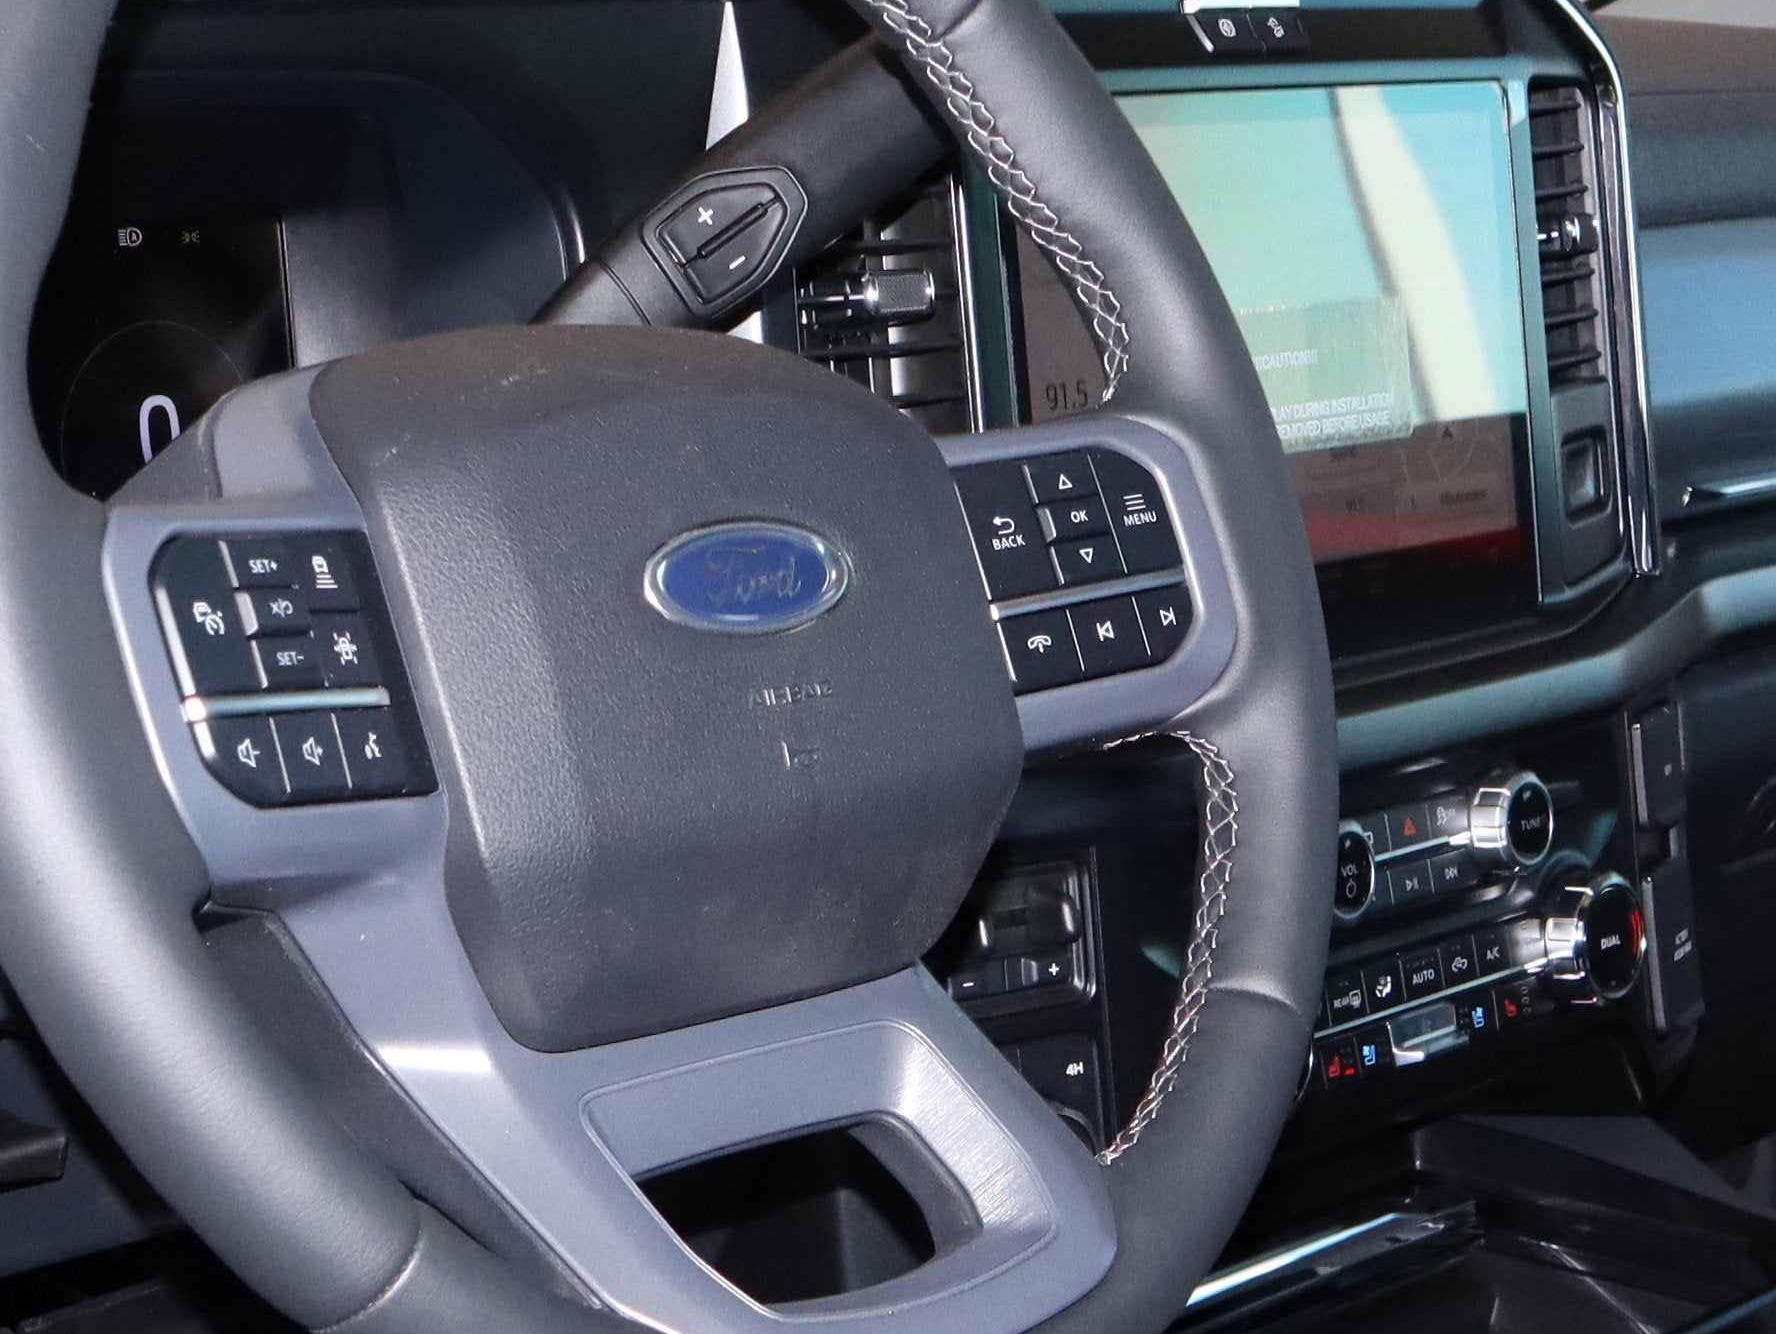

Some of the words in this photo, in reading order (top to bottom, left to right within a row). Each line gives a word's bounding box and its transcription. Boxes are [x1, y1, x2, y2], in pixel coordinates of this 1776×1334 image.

[1044, 382, 1090, 412] 91.5
[1070, 509, 1089, 524] OK
[1123, 509, 1158, 527] MENU
[991, 534, 1026, 551] BACK
[1600, 933, 1621, 949] DUAL
[1412, 969, 1435, 985] AUTO
[1066, 1061, 1084, 1077] 4H
